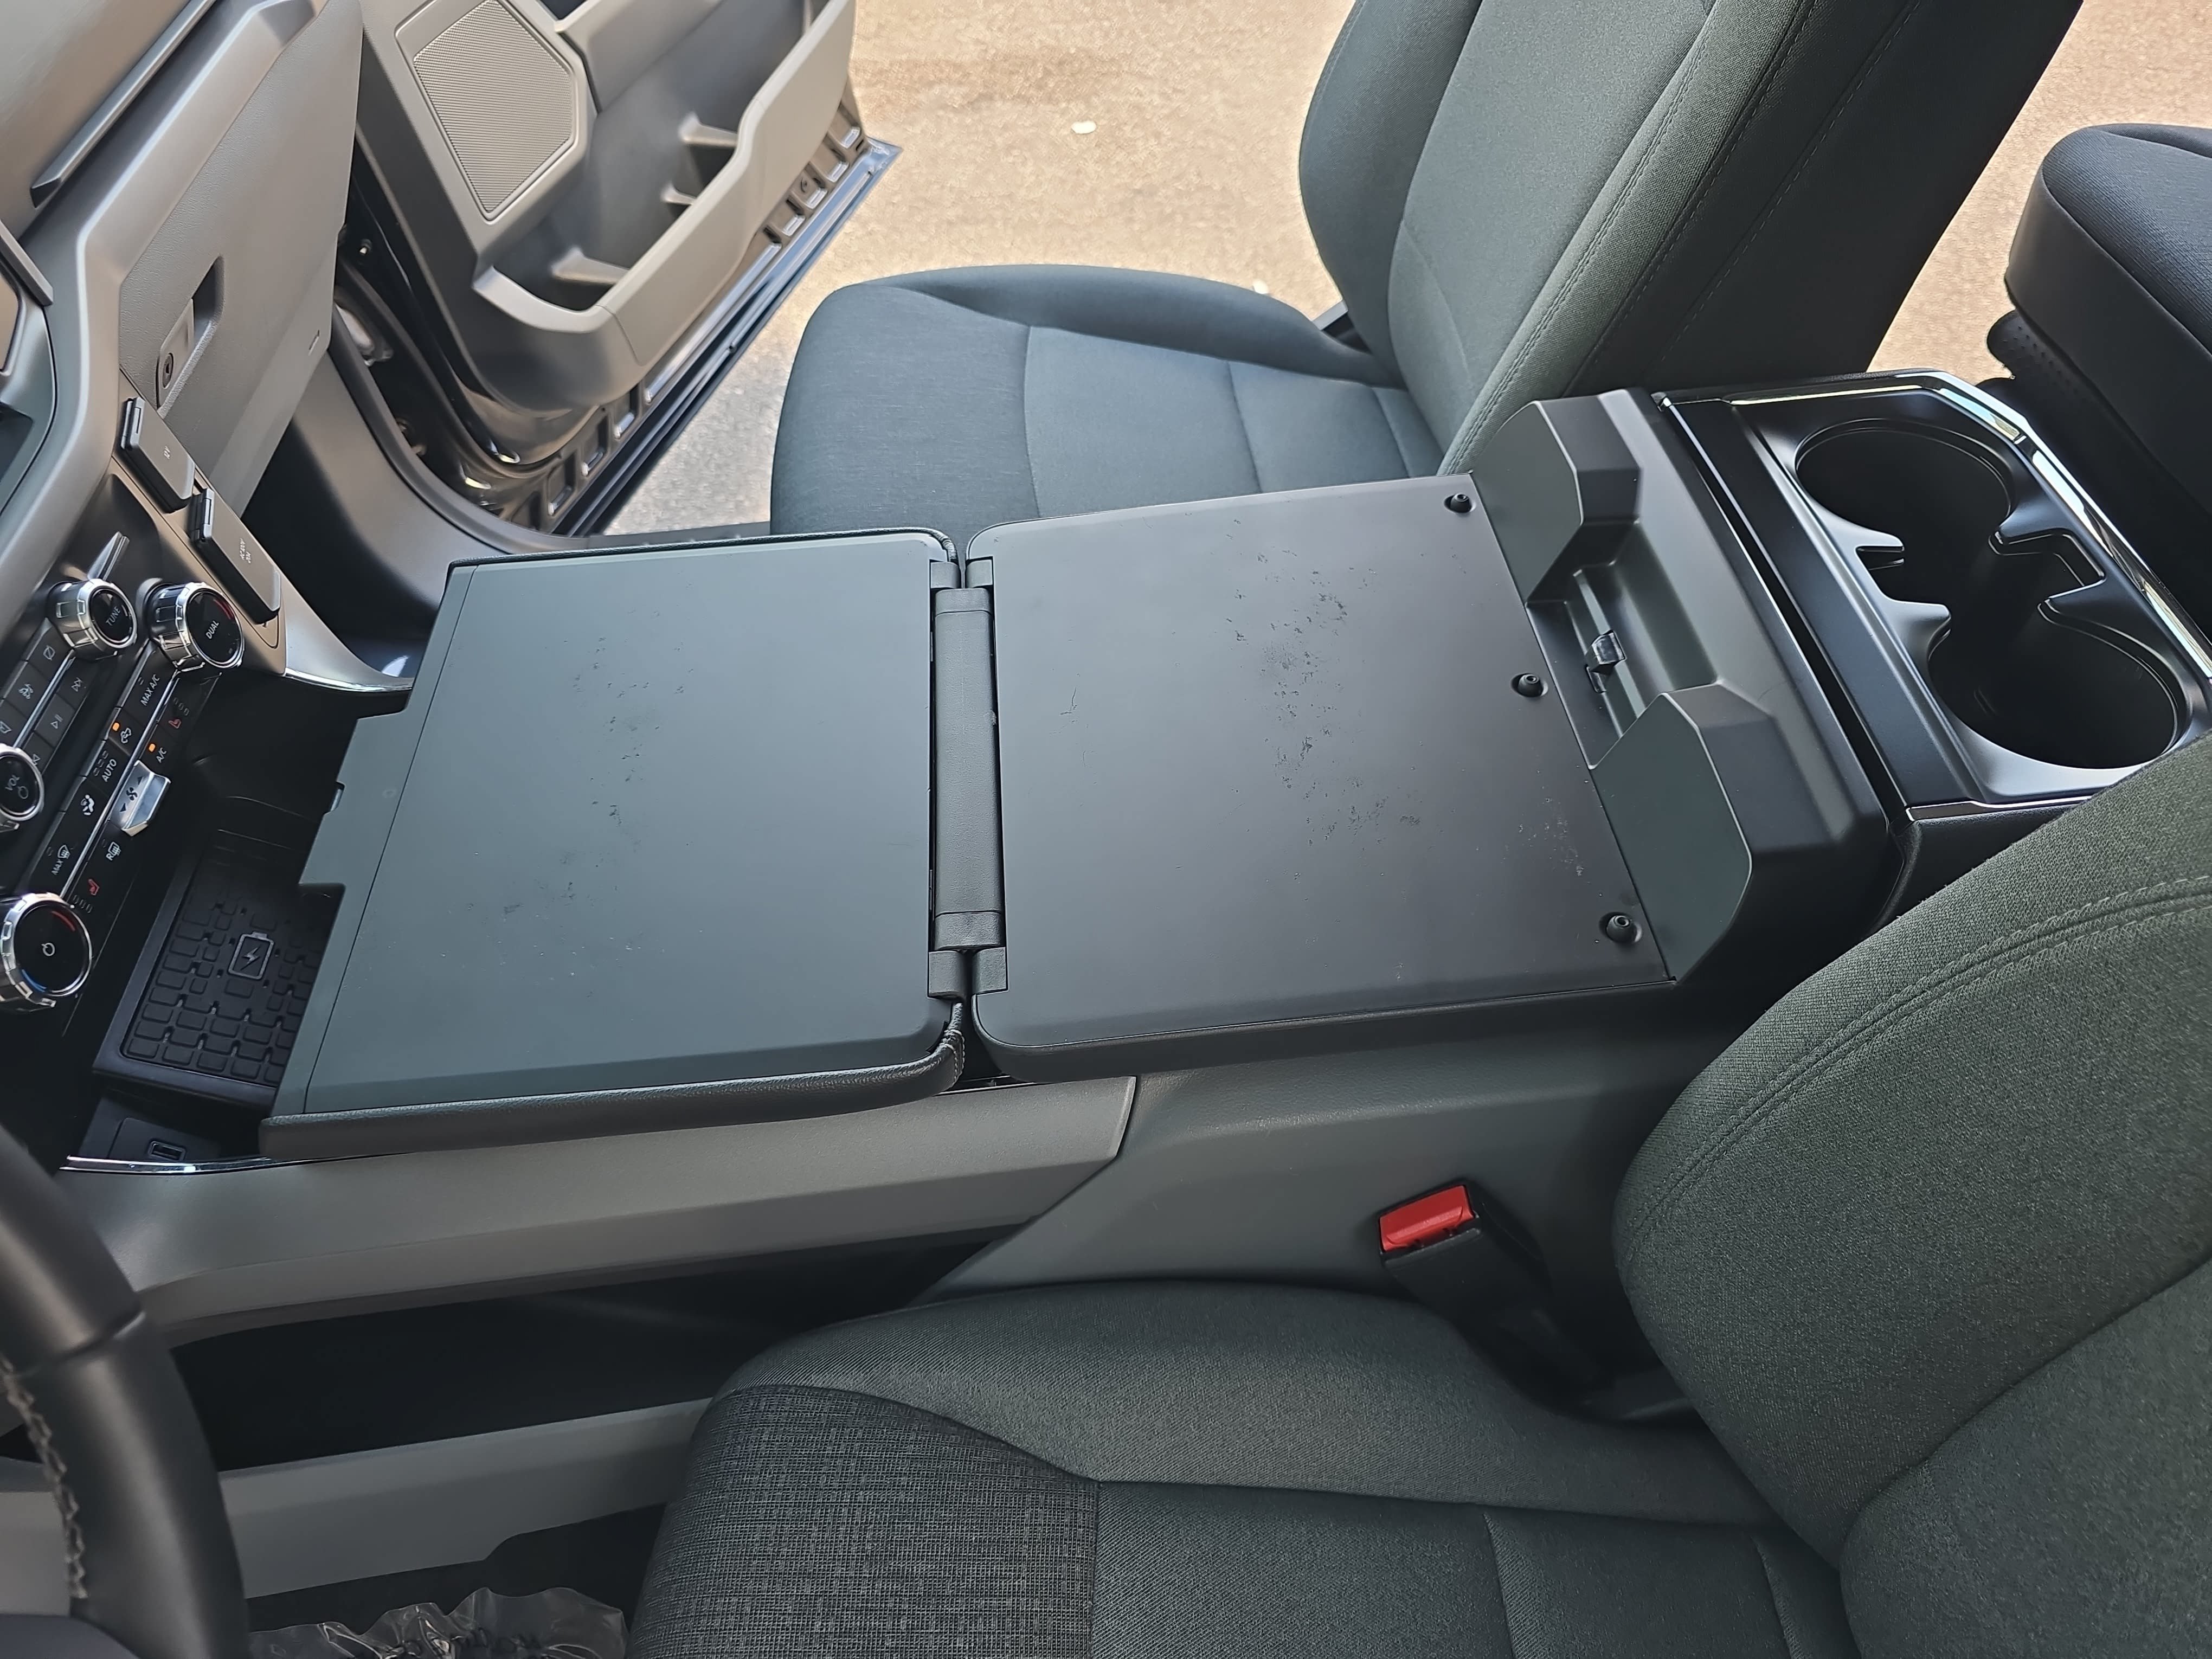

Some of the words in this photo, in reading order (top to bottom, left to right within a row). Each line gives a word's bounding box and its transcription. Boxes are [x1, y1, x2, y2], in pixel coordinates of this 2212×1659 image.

[105, 606, 121, 626] TUNE
[205, 620, 219, 639] DUAL
[140, 687, 153, 706] MAX
[149, 674, 160, 690] A/C
[156, 747, 167, 763] A/C
[101, 759, 117, 782] AUTO
[4, 775, 20, 790] VOL
[106, 853, 114, 861] R
[52, 859, 64, 875] MAX
